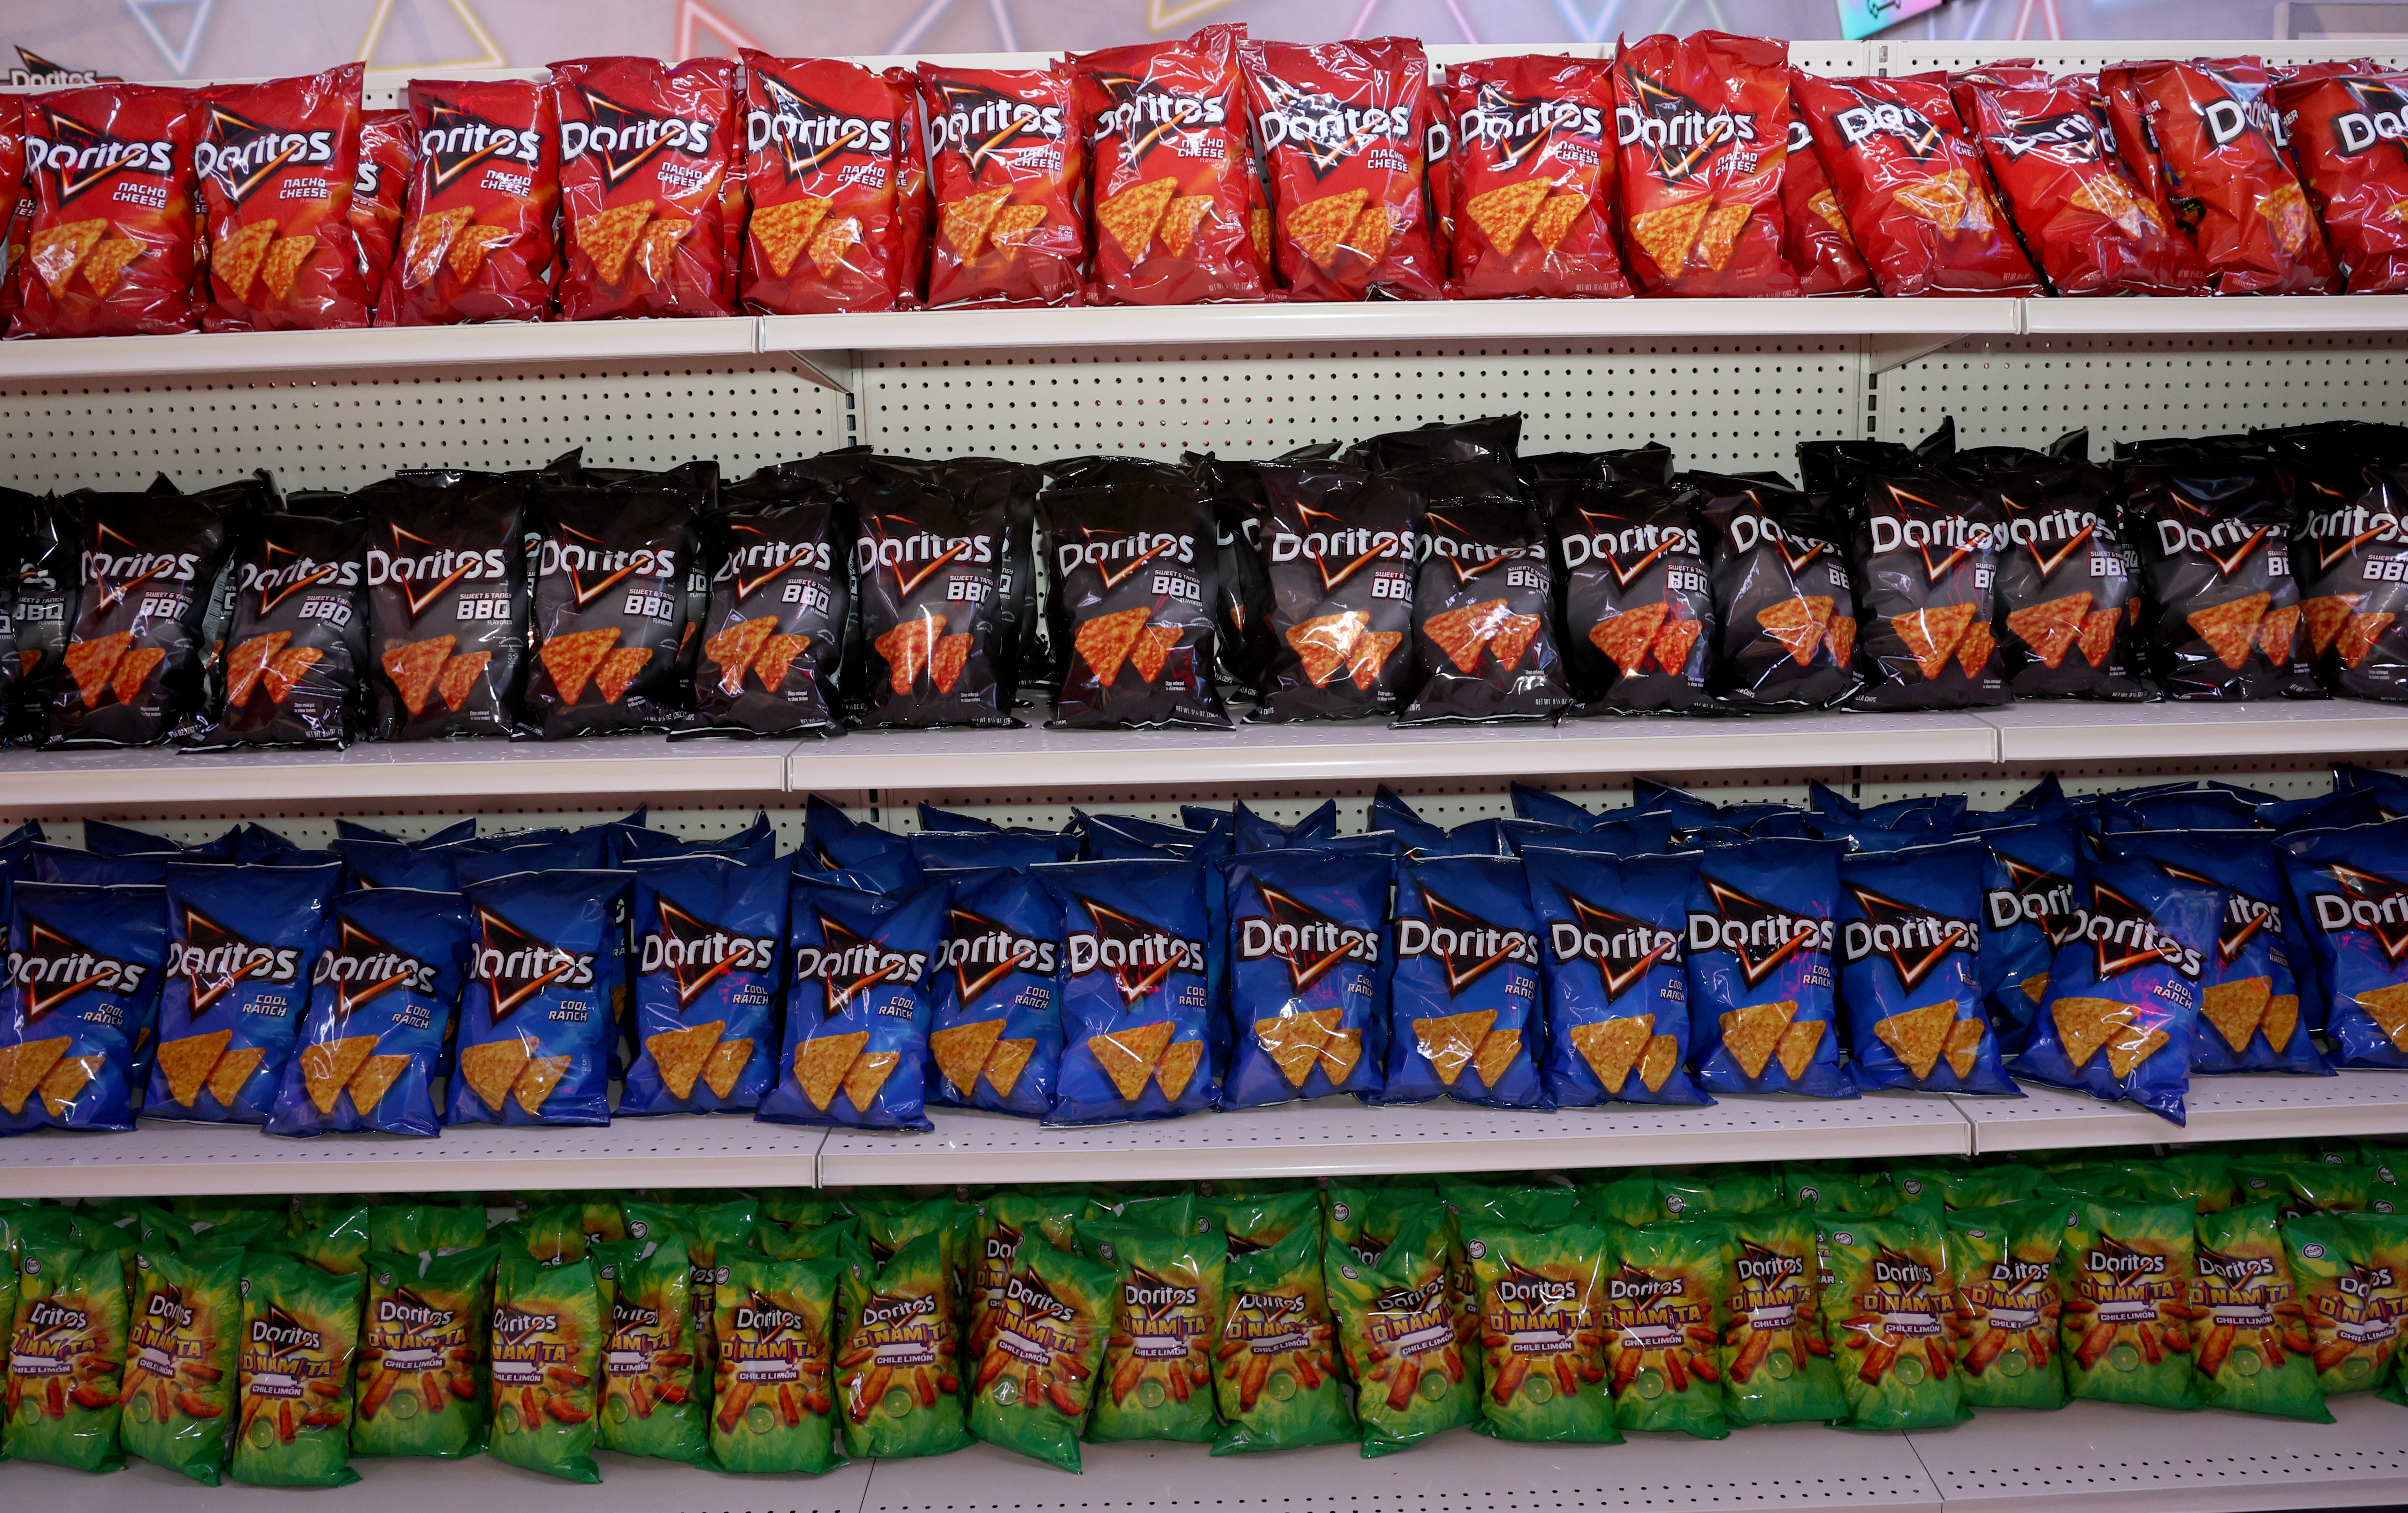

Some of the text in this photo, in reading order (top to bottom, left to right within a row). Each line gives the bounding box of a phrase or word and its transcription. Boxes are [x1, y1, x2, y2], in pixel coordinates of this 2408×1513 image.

[747, 110, 891, 152] Doritos
[931, 99, 1064, 157] Doritos
[1259, 106, 1410, 152] Doritos
[1461, 102, 1602, 147] Doritos
[1616, 107, 1754, 147] Doritos
[562, 118, 710, 161] Doritos
[25, 138, 174, 172] Doritos
[195, 131, 331, 179] Doritos
[1018, 148, 1061, 161] NACHO
[1178, 147, 1225, 159] CHEESE
[1371, 148, 1405, 162] NACHO
[1555, 150, 1600, 166] CHEESE
[1558, 141, 1598, 157] NACHO
[1014, 158, 1061, 171] CHEESE
[1368, 160, 1408, 173] CHEESE
[1717, 152, 1758, 165] NACHO
[486, 170, 532, 186] NACHO
[662, 161, 703, 178] NACHO
[842, 164, 885, 178] NACHO
[1715, 161, 1757, 177] CHEESE
[284, 177, 326, 188] NACHO
[480, 179, 530, 197] CHEESE
[657, 171, 703, 189] CHEESE
[837, 173, 884, 189] CHEESE
[857, 184, 882, 194] FLAVORED
[118, 182, 167, 198] NACHO
[279, 187, 328, 199] CHEESE
[112, 192, 166, 209] CHEESE
[857, 531, 993, 575] Doritos
[1272, 528, 1414, 562] Doritos
[1562, 525, 1700, 570] Doritos
[540, 540, 675, 578] Doritos
[1059, 532, 1194, 578] Doritos
[81, 550, 200, 586] Doritos
[241, 557, 362, 593] Doritos
[367, 549, 505, 586] Doritos
[1184, 574, 1200, 584] TANGY
[1506, 570, 1550, 597] BBQ
[659, 591, 675, 601] TANGY
[817, 582, 831, 595] TANGY
[947, 582, 992, 602] BBQ
[1152, 576, 1201, 601] BBQ
[624, 595, 674, 620] BBQ
[782, 584, 830, 613] BBQ
[1180, 597, 1202, 607] FLAVORED
[140, 598, 189, 621] BBQ
[298, 600, 352, 626] BBQ
[457, 600, 511, 620] BBQ
[810, 607, 829, 620] FLAVORED
[323, 620, 344, 632] FLAVORED
[653, 618, 673, 627] FLAVORED
[1221, 675, 1233, 684] CHIPS
[1263, 707, 1274, 715] CHIPS
[1243, 919, 1379, 962] Doritos
[1689, 914, 1834, 950] Doritos
[1845, 917, 1978, 961] Doritos
[1400, 920, 1538, 965] Doritos
[167, 942, 298, 979] Doritos
[642, 932, 774, 972] Doritos
[933, 931, 1057, 973] Doritos
[1069, 933, 1204, 973] Doritos
[8, 952, 145, 992] Doritos
[313, 950, 436, 992] Doritos
[798, 945, 928, 983] Doritos
[744, 984, 767, 995] COOL
[1668, 979, 1683, 991] COOL
[1802, 975, 1831, 988] RANCH
[2167, 980, 2193, 1000] COOL
[256, 995, 287, 1006] COOL
[732, 994, 769, 1005] RANCH
[1026, 986, 1050, 999] COOL
[1660, 988, 1684, 1001] RANCH
[2153, 985, 2192, 1010] RANCH
[98, 1003, 123, 1018] COOL
[242, 1004, 287, 1016] RANCH
[405, 1004, 431, 1019] COOL
[560, 1001, 587, 1011] COOL
[891, 996, 914, 1009] COOL
[1015, 996, 1049, 1009] RANCH
[84, 1011, 123, 1027] RANCH
[392, 1014, 429, 1029] RANCH
[549, 1011, 587, 1021] RANCH
[879, 1006, 913, 1020] RANCH
[1739, 1257, 1802, 1279] Doritos
[2092, 1251, 2164, 1272] Doritos
[2199, 1257, 2274, 1278] Doritos
[1876, 1262, 1932, 1282] Doritos
[1125, 1285, 1196, 1305] Doritos
[1502, 1281, 1575, 1300] Doritos
[1611, 1279, 1682, 1298] Doritos
[1007, 1278, 1074, 1322] Doritos
[381, 1302, 454, 1326] Doritos
[738, 1308, 802, 1330] Doritos
[863, 1295, 935, 1326] Doritos
[2100, 1310, 2155, 1321] CHILE LIMÓN
[493, 1308, 556, 1332] Doritos
[1753, 1319, 1780, 1328] CHILE
[1913, 1324, 1940, 1333] LIMÓN
[253, 1322, 320, 1348] Doritos
[1651, 1335, 1681, 1346] LIMÓN
[1513, 1341, 1572, 1351] CHILE LIMÓN
[877, 1356, 903, 1364] CHILE
[739, 1372, 766, 1381] CHILE
